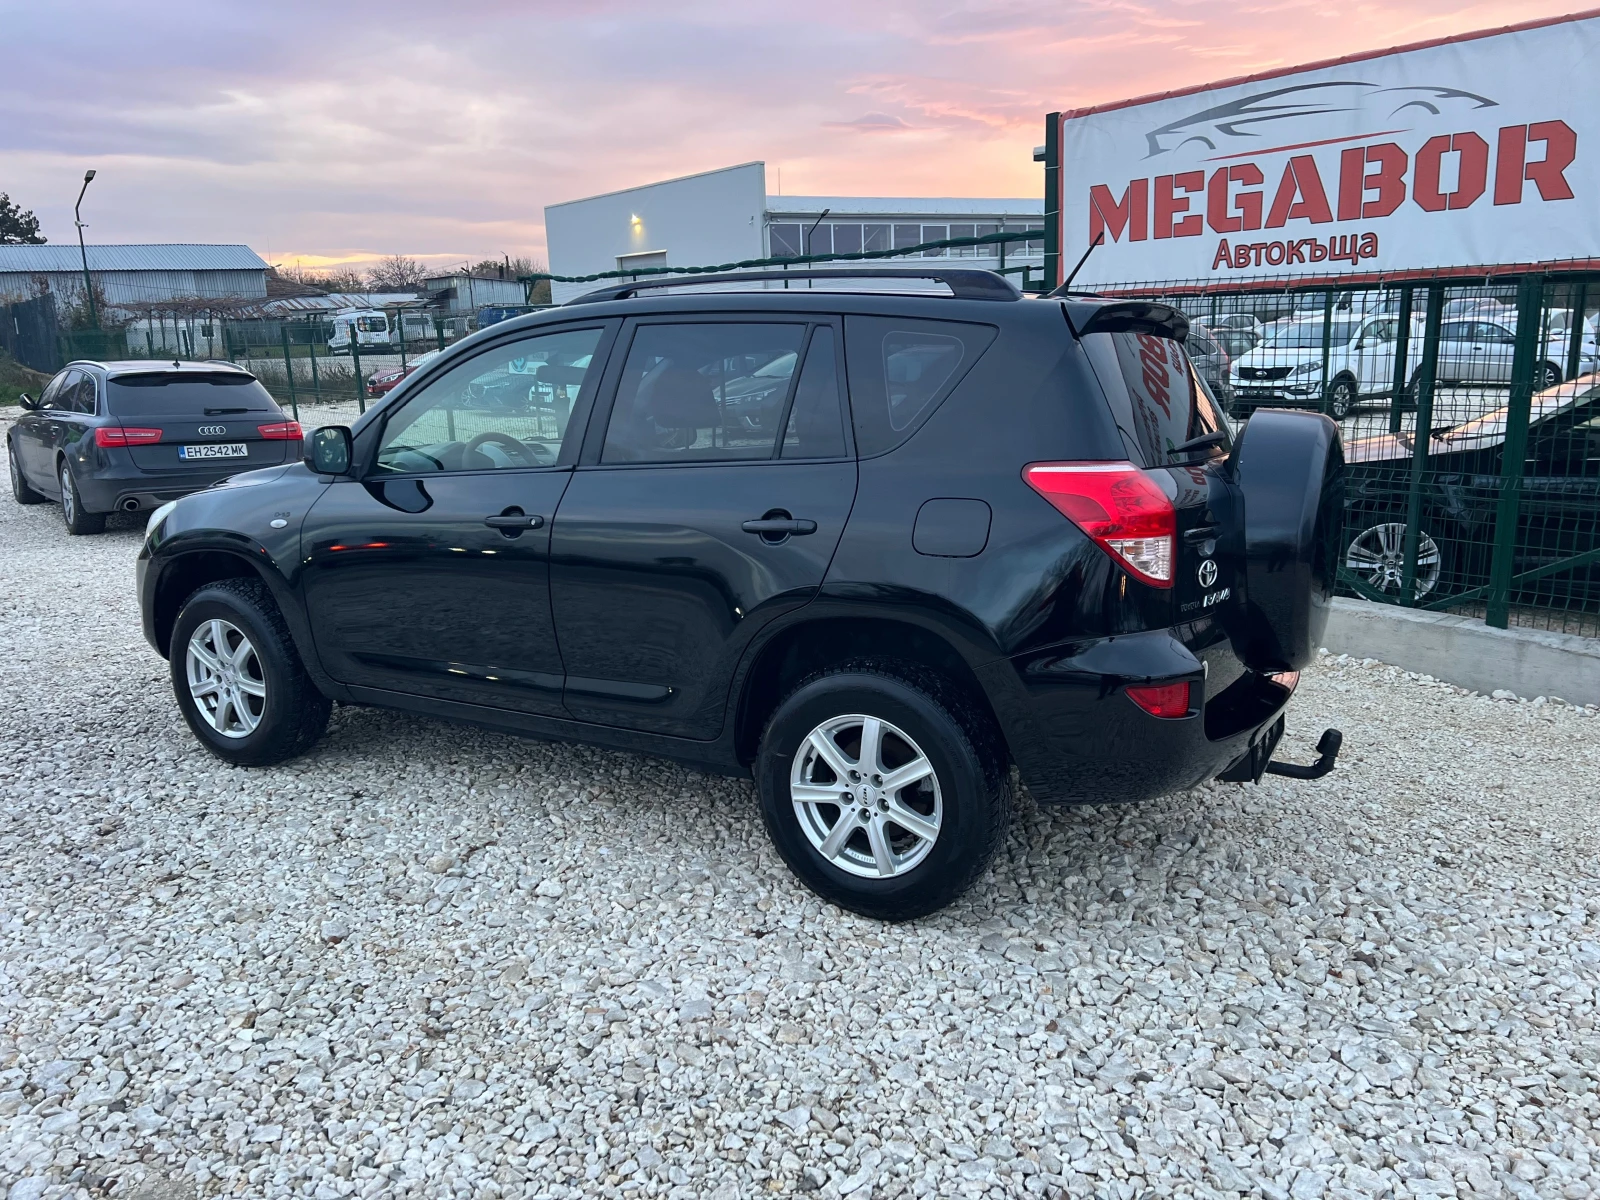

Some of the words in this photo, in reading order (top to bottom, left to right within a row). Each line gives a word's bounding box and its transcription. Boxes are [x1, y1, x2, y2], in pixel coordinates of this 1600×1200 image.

[1089, 119, 1577, 247] MEGABOR
[1212, 232, 1379, 270] Автокъща
[186, 447, 202, 458] EH
[203, 446, 230, 457] 2542
[231, 445, 245, 456] MK
